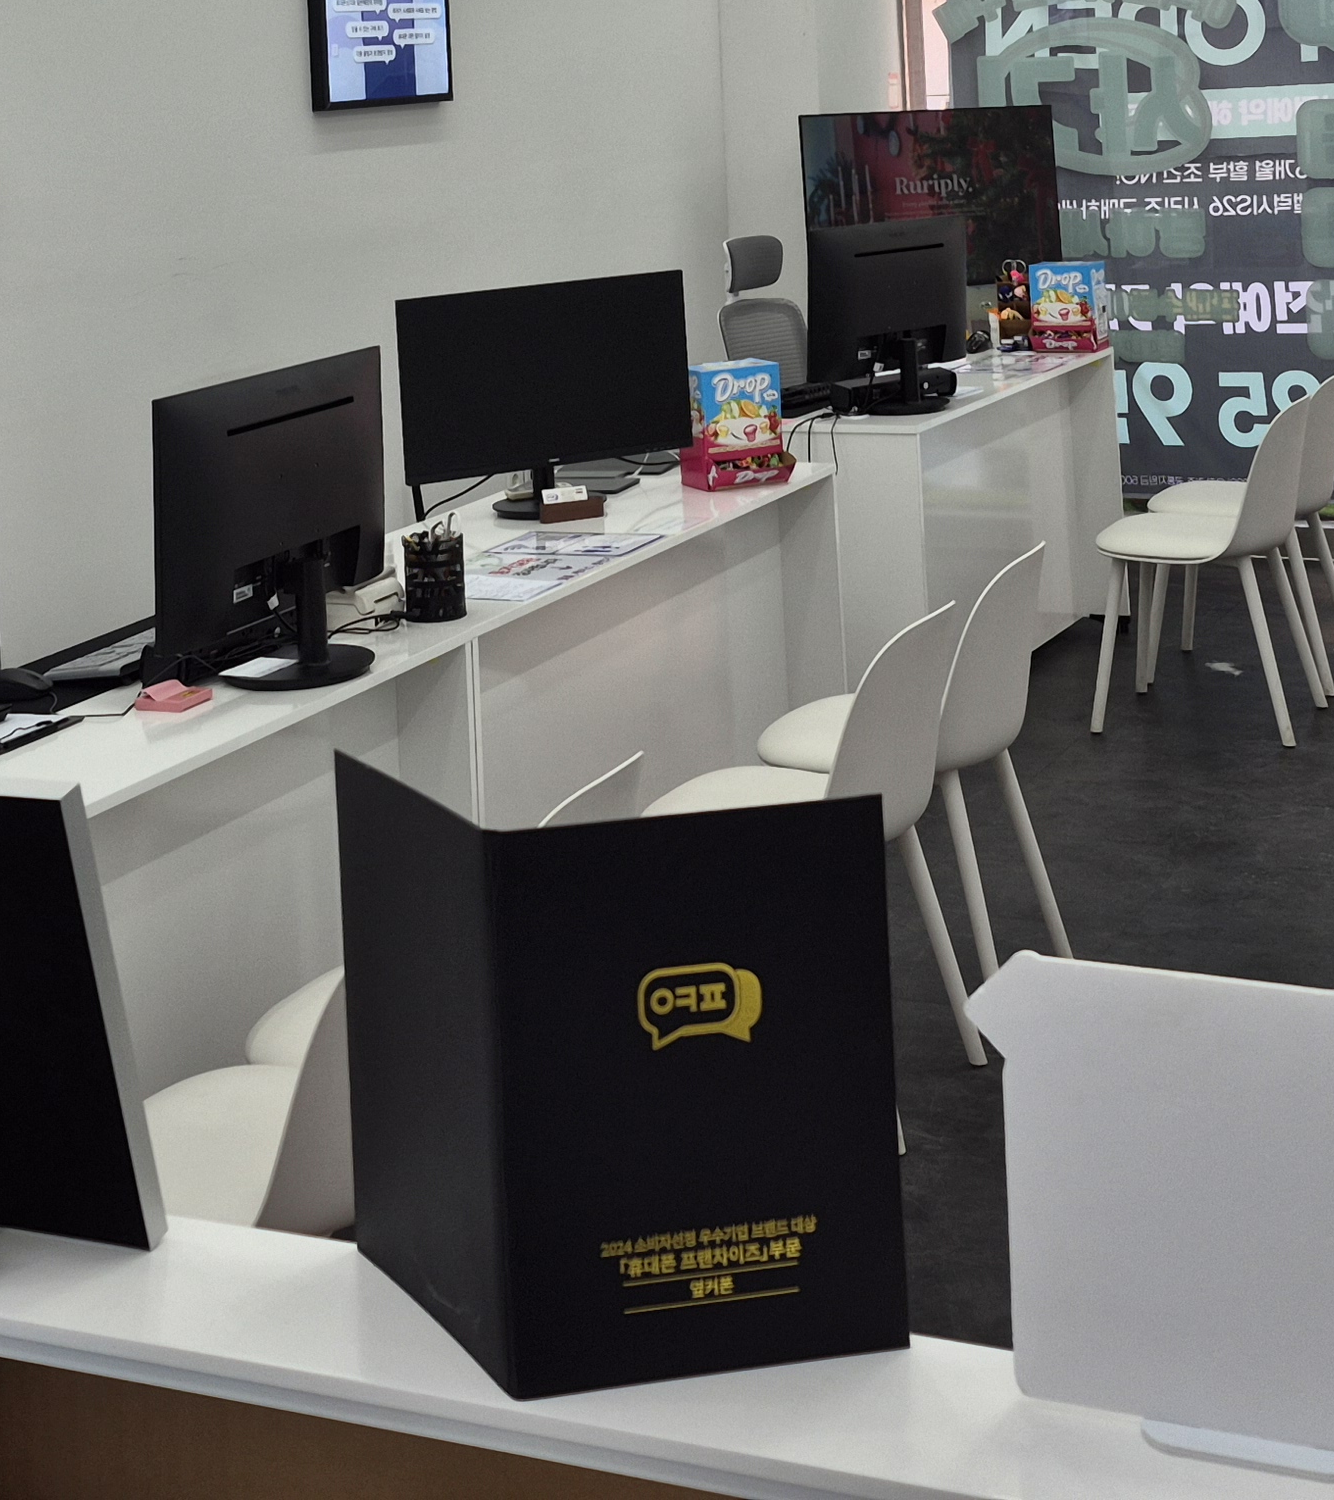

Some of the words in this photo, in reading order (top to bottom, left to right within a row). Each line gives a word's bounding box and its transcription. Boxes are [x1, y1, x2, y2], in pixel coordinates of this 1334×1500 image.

[895, 174, 973, 197] Ruriply.
[1036, 269, 1082, 295] Drop
[712, 372, 771, 405] Drop
[600, 1238, 633, 1258] 2024
[634, 1229, 696, 1254] 소비자선정
[698, 1222, 749, 1246] 우수기업
[751, 1218, 789, 1238] 브랜드
[791, 1213, 817, 1234] 대상
[690, 1275, 735, 1299] 옆커폰
